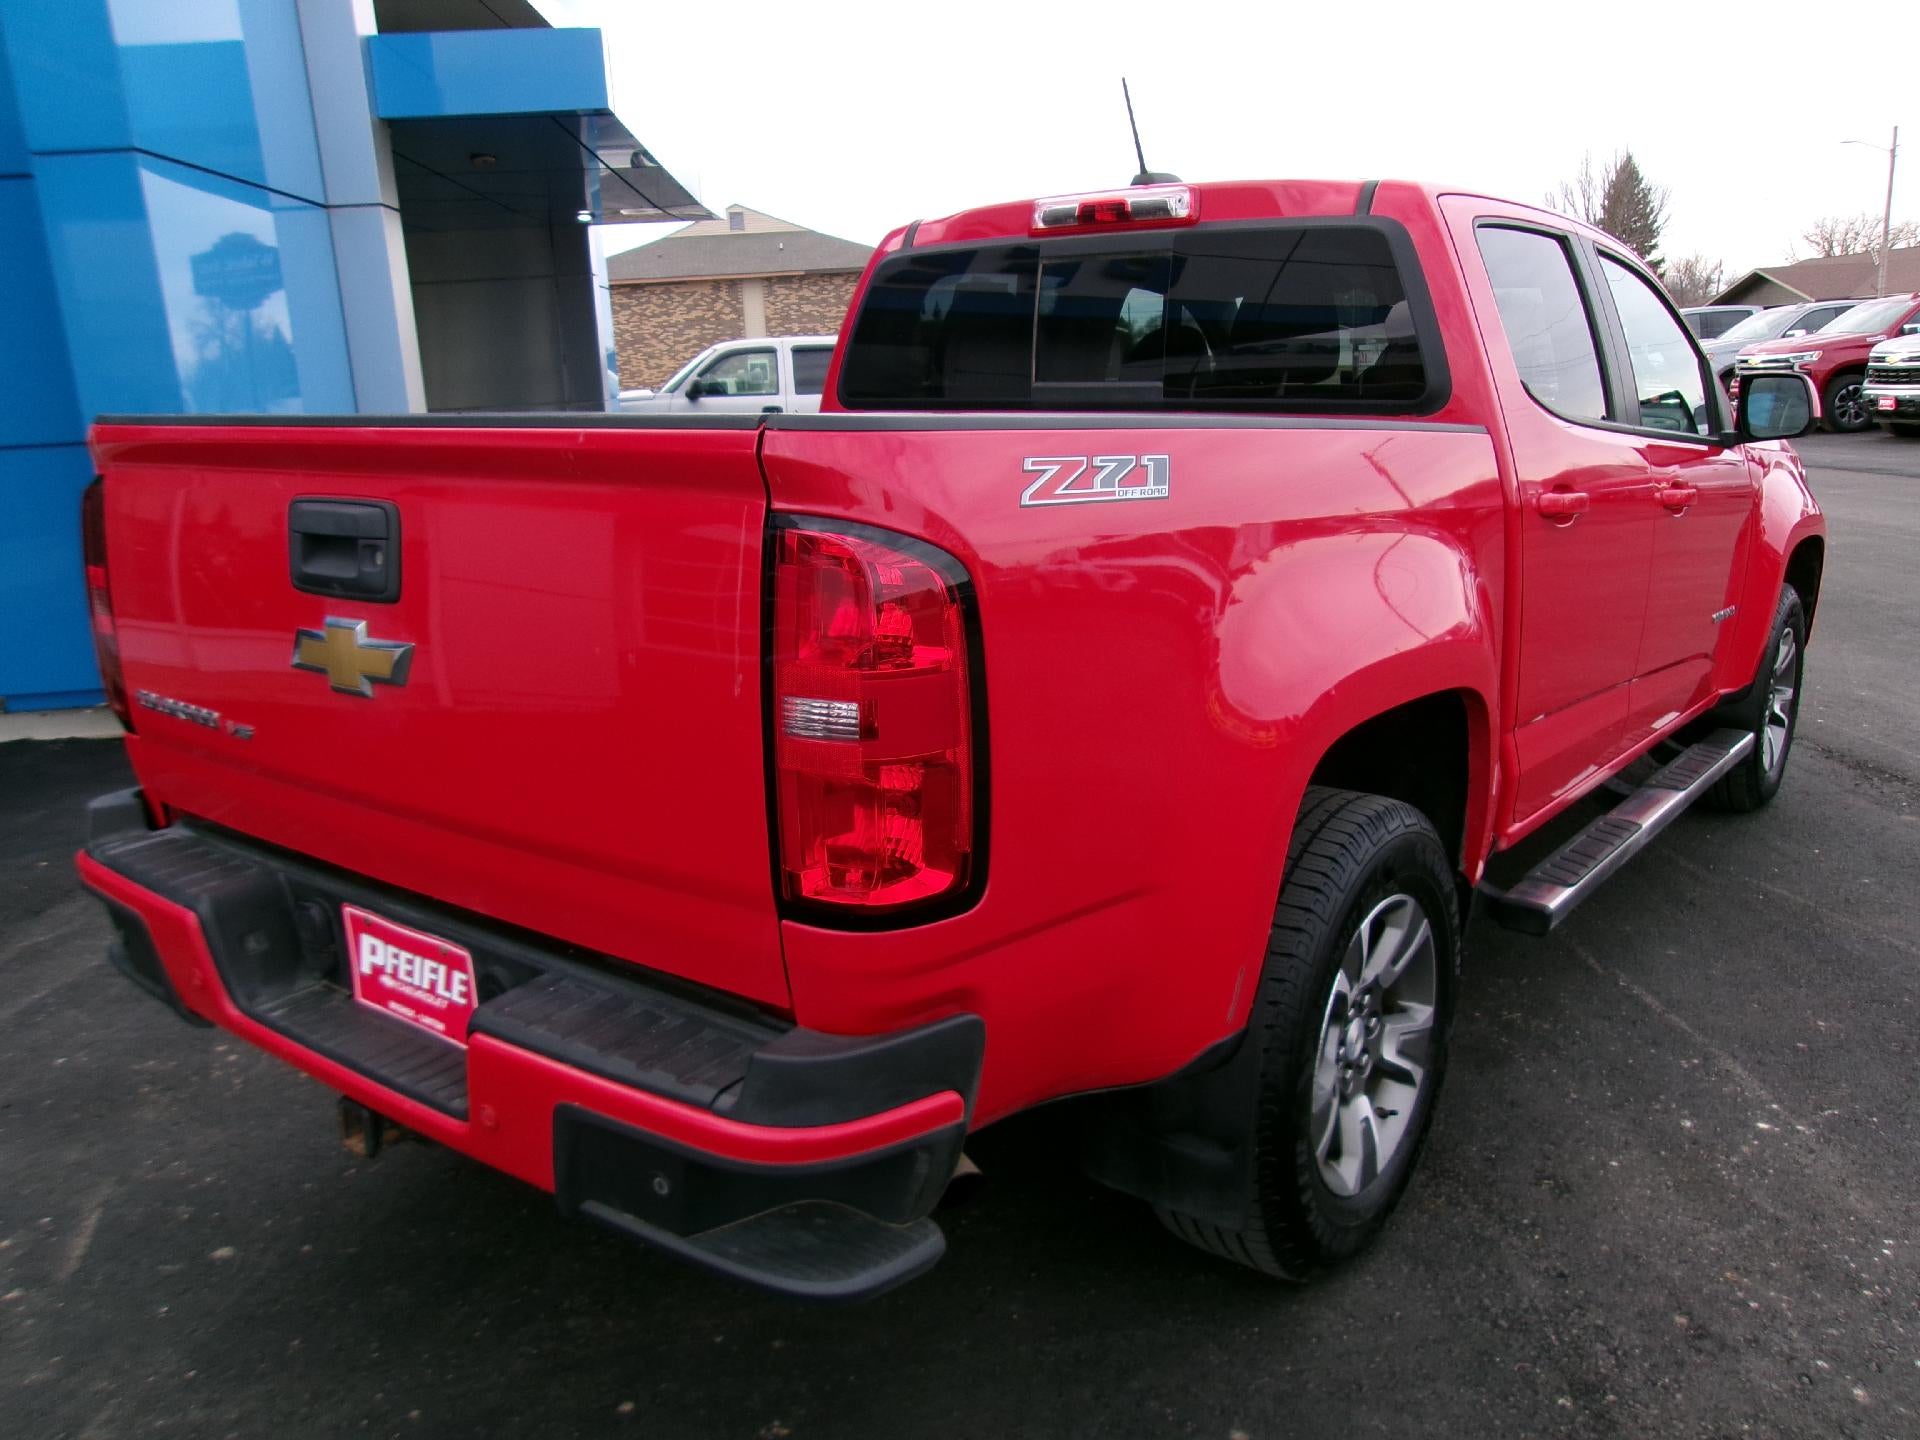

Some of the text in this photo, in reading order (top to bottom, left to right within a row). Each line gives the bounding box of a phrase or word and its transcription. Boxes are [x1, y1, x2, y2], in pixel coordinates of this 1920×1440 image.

[1020, 454, 1170, 508] Z71
[1117, 486, 1168, 498] OFF ROAD
[359, 932, 469, 1006] PFEIFLE
